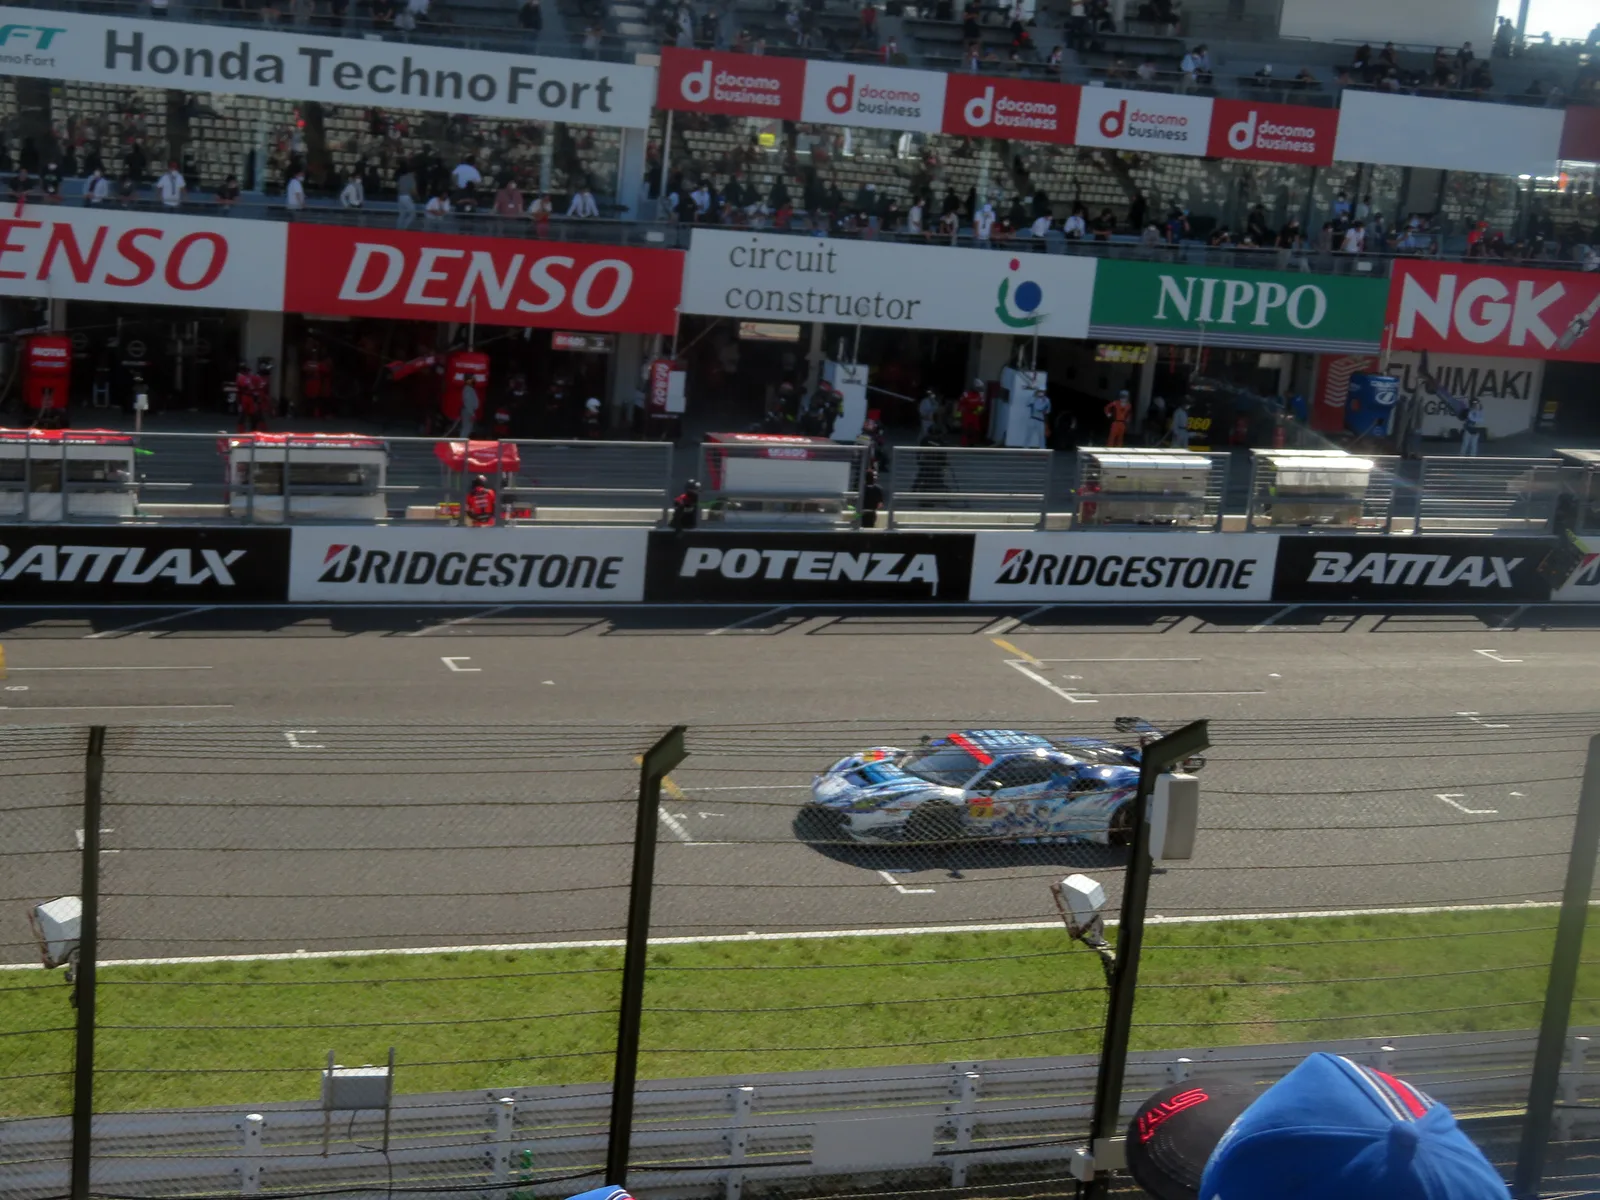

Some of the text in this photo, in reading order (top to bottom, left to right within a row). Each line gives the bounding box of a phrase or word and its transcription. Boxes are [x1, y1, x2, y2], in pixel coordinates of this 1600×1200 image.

[104, 29, 613, 112] Honda Techno Fort
[715, 71, 780, 90] docomo
[714, 86, 780, 106] business
[857, 101, 921, 118] business
[859, 84, 921, 102] docomo
[995, 96, 1056, 114] docomo
[994, 112, 1057, 130] business
[1128, 124, 1188, 141] business
[1130, 108, 1188, 126] docomo
[1258, 121, 1315, 138] docomo
[1256, 136, 1315, 153] business
[729, 237, 838, 274] circuit
[337, 242, 634, 317] DENSO
[725, 284, 921, 321] constructor
[1153, 275, 1326, 329] NIPPO
[1396, 273, 1566, 350] NGK
[0, 545, 247, 585] ATTLAX
[318, 544, 623, 589] BRIDGESTONE
[680, 547, 939, 597] POTENZA
[995, 548, 1257, 590] BRIDGESTONE
[1307, 551, 1524, 588] BATTLAX
